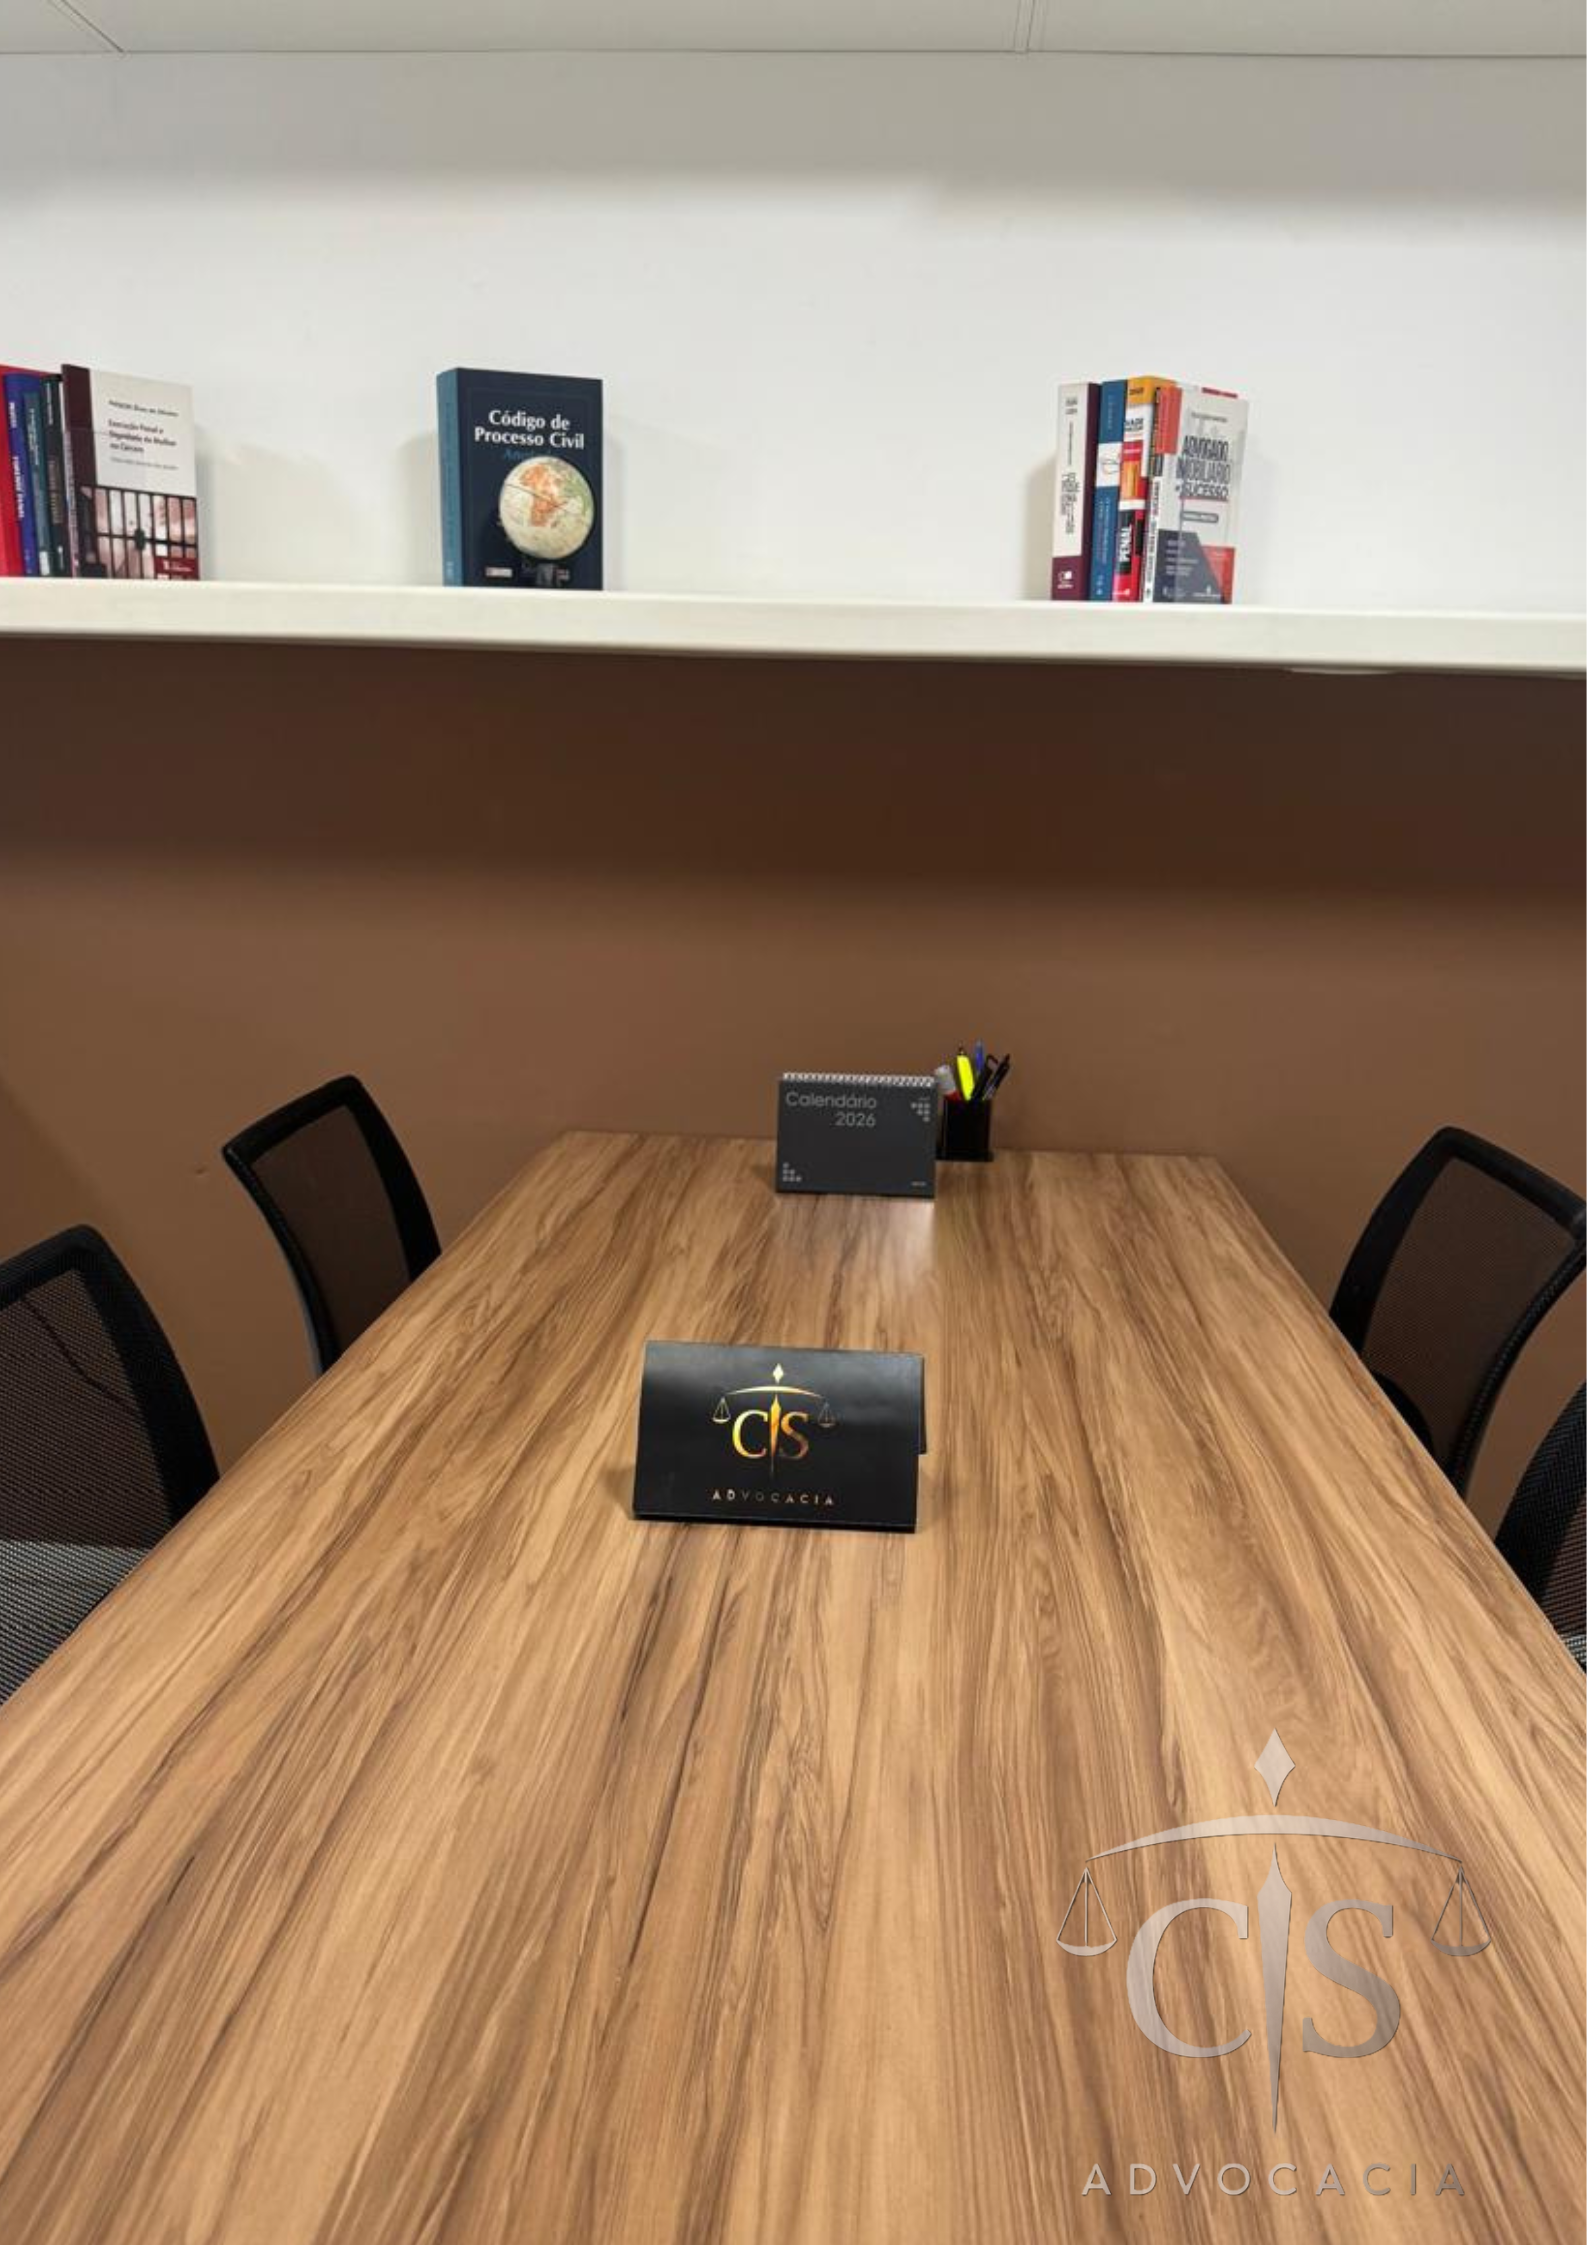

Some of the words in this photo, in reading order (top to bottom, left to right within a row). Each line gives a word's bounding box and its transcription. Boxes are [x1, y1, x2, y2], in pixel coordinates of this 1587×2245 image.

[488, 410, 546, 432] Código
[550, 414, 570, 430] de
[474, 426, 544, 446] Processo
[549, 432, 584, 449] Civil
[785, 1091, 877, 1110] Calendário
[835, 1112, 876, 1127] 2026
[712, 1488, 834, 1506] ADVOCACIA
